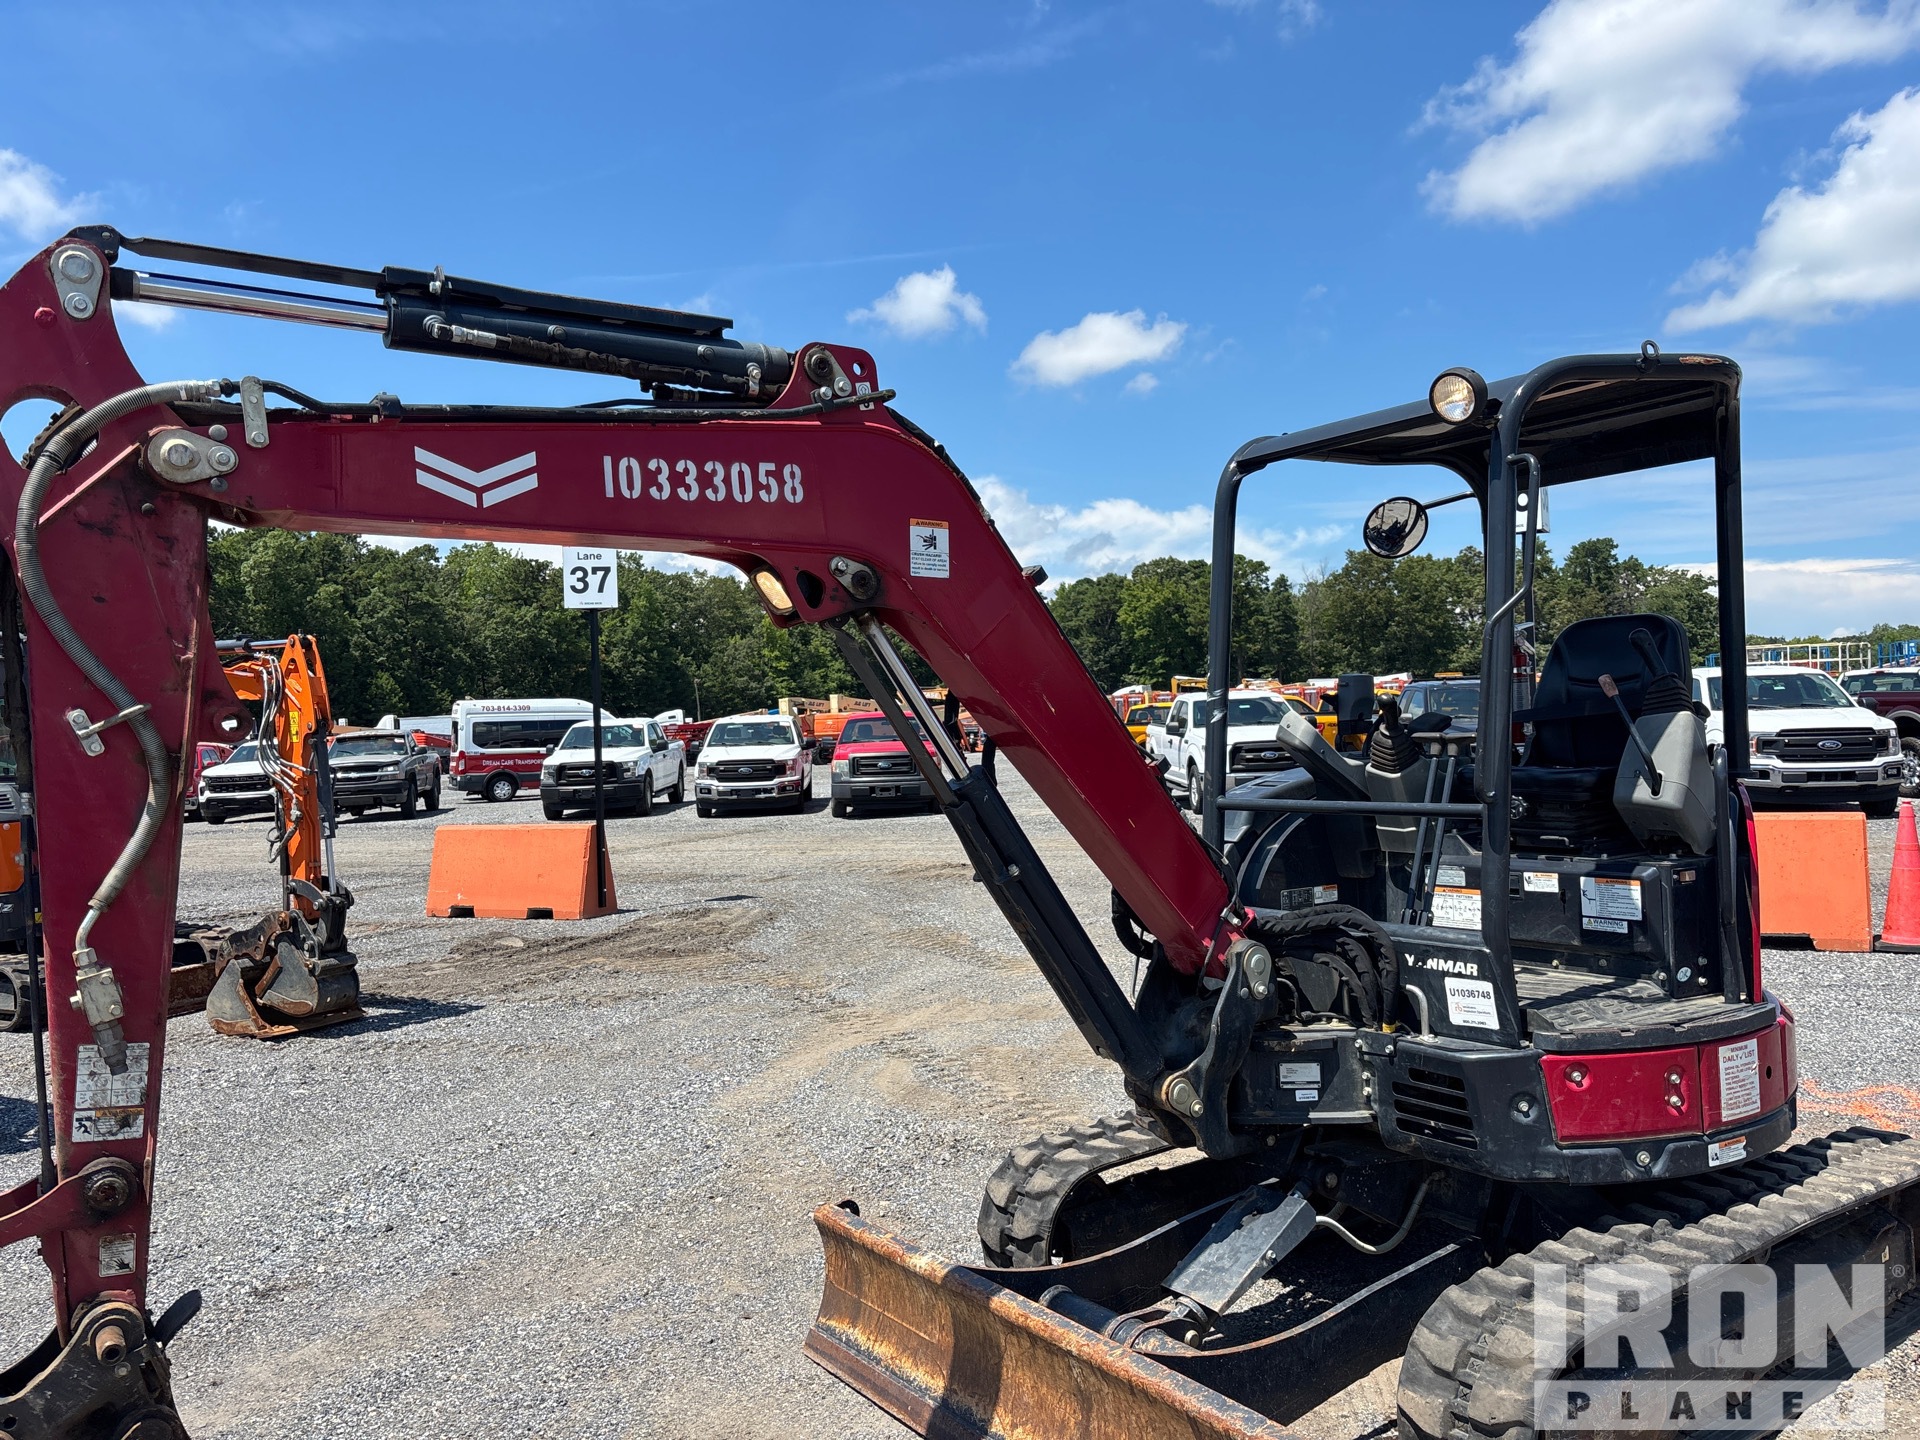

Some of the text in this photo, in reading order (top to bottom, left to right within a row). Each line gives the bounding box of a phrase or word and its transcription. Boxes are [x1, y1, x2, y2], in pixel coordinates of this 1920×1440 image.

[603, 456, 804, 503] 10333058
[577, 552, 602, 561] Lane
[570, 566, 611, 594] 37
[1592, 919, 1624, 927] WARNING
[1449, 988, 1492, 1000] U1036748
[1731, 1044, 1748, 1053] MINIMUM
[1723, 1049, 1755, 1063] DAILY LIST
